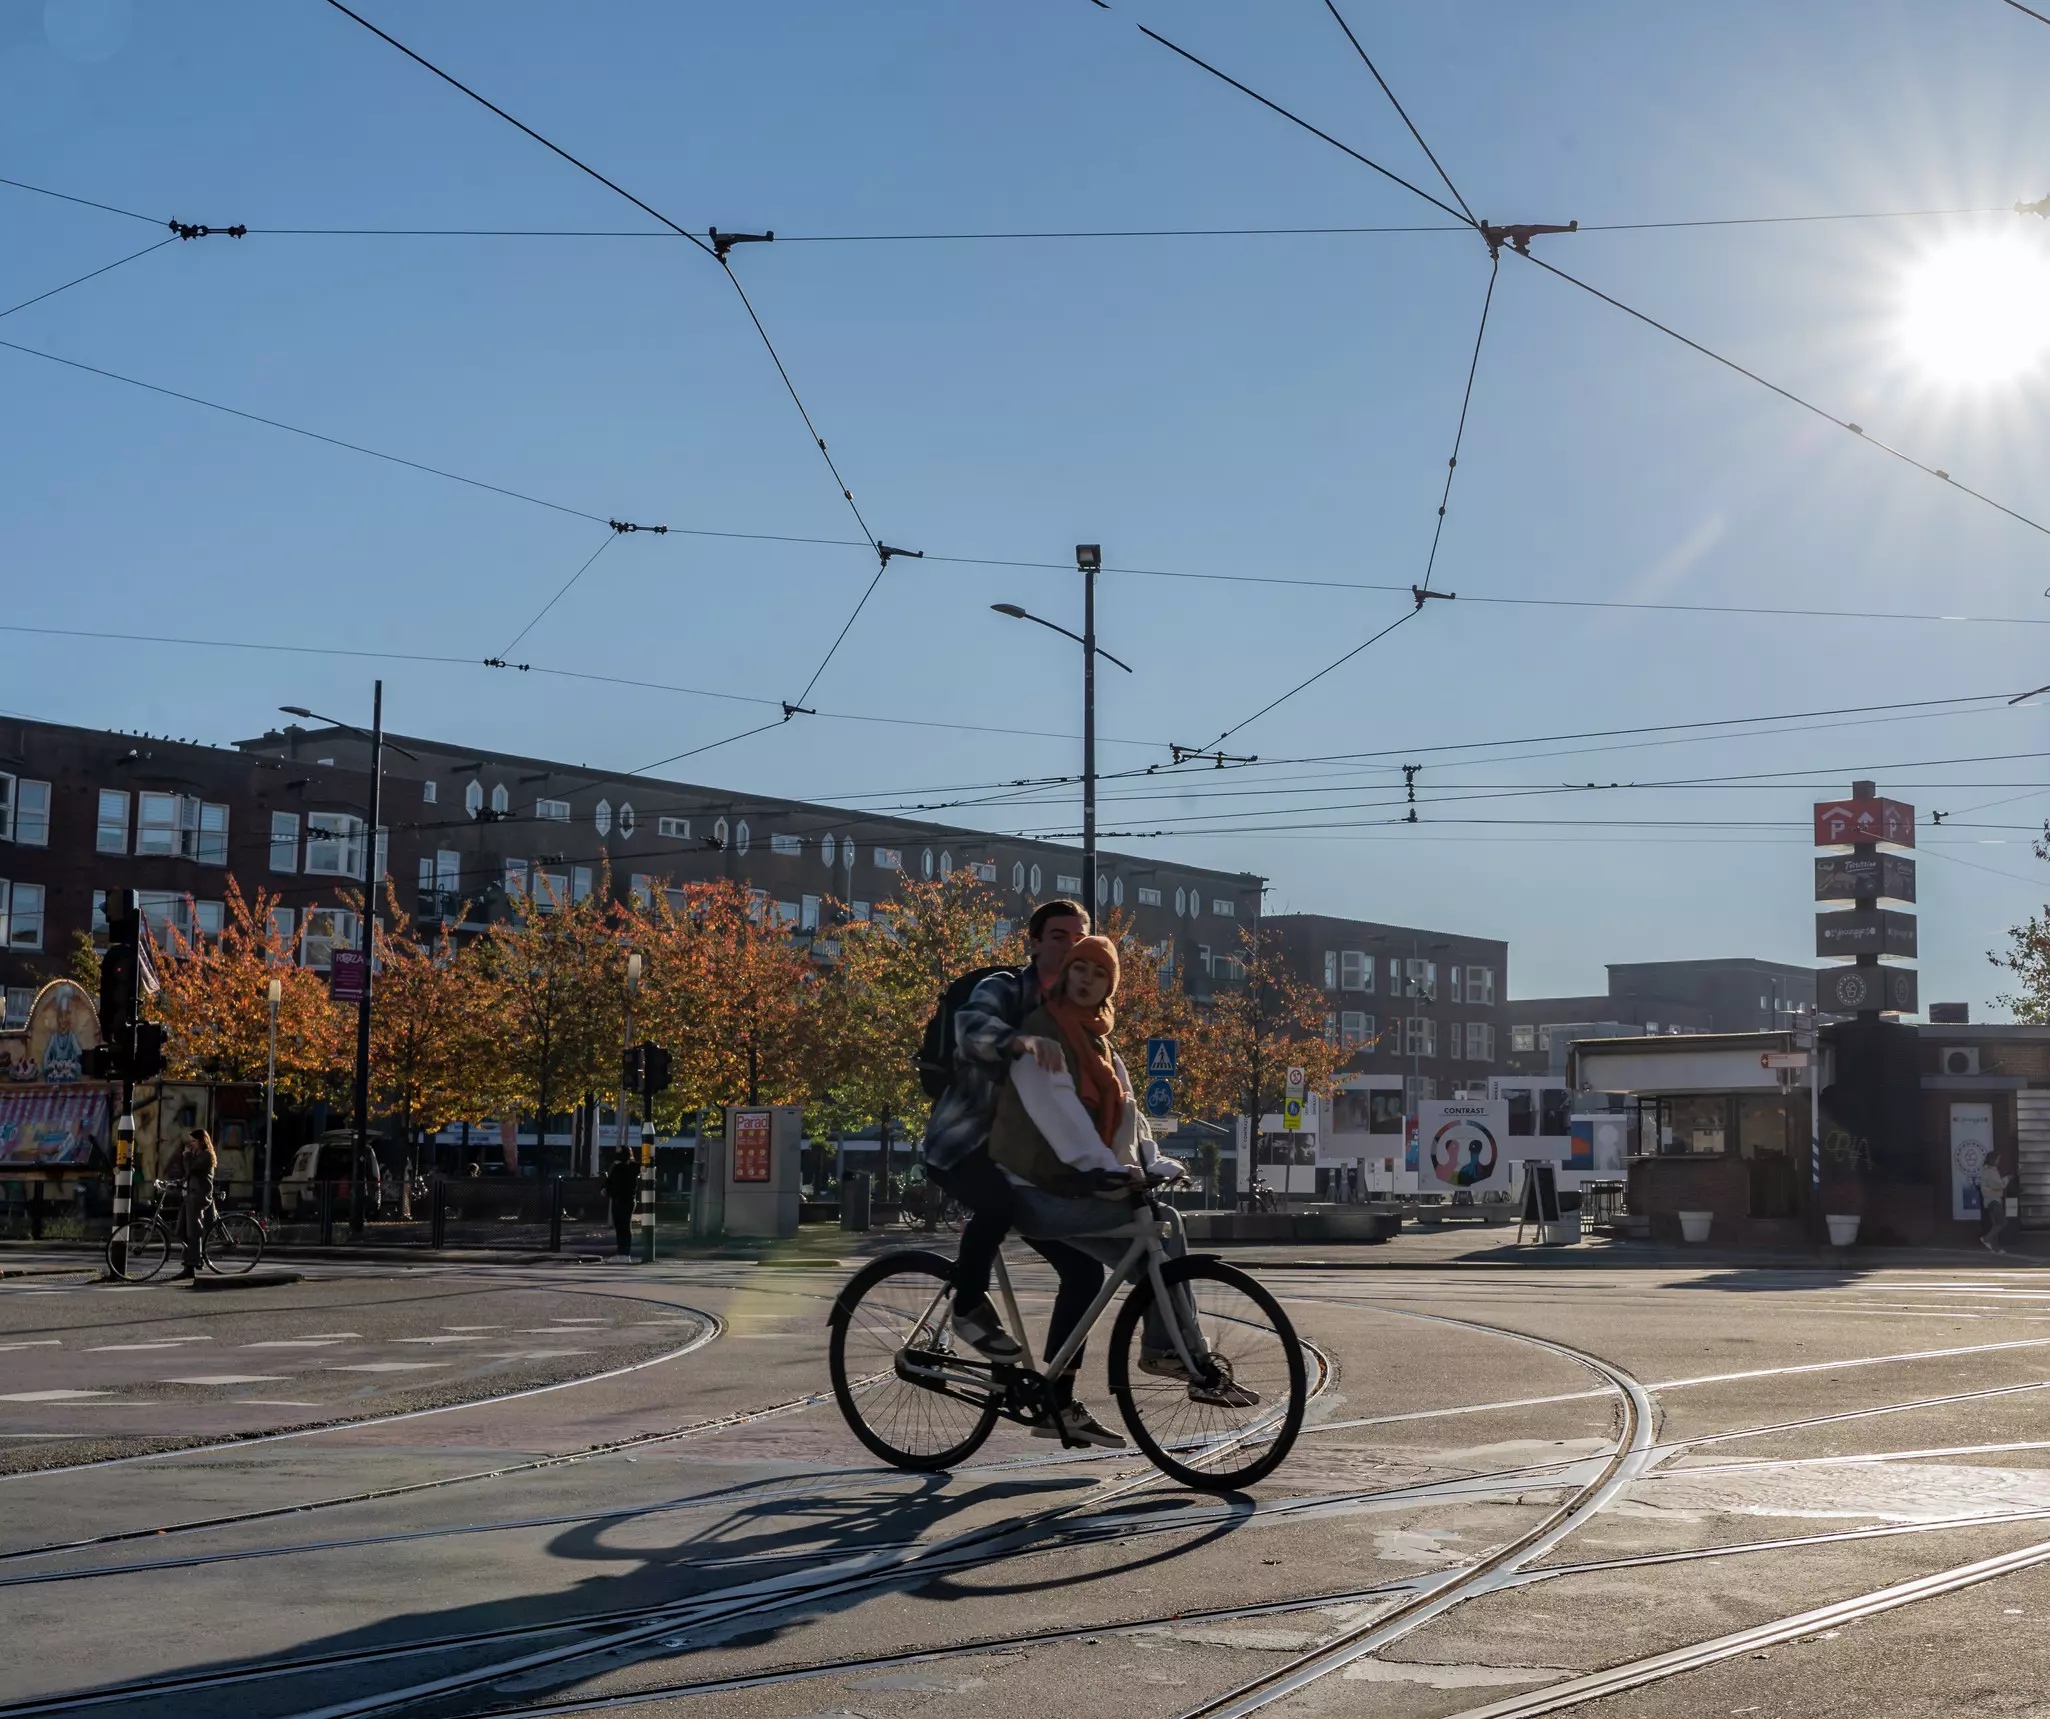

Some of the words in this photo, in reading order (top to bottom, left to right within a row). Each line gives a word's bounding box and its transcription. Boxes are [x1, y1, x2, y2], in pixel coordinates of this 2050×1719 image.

[1831, 820, 1845, 840] P
[1889, 818, 1897, 838] P
[737, 1115, 768, 1129] Parad
